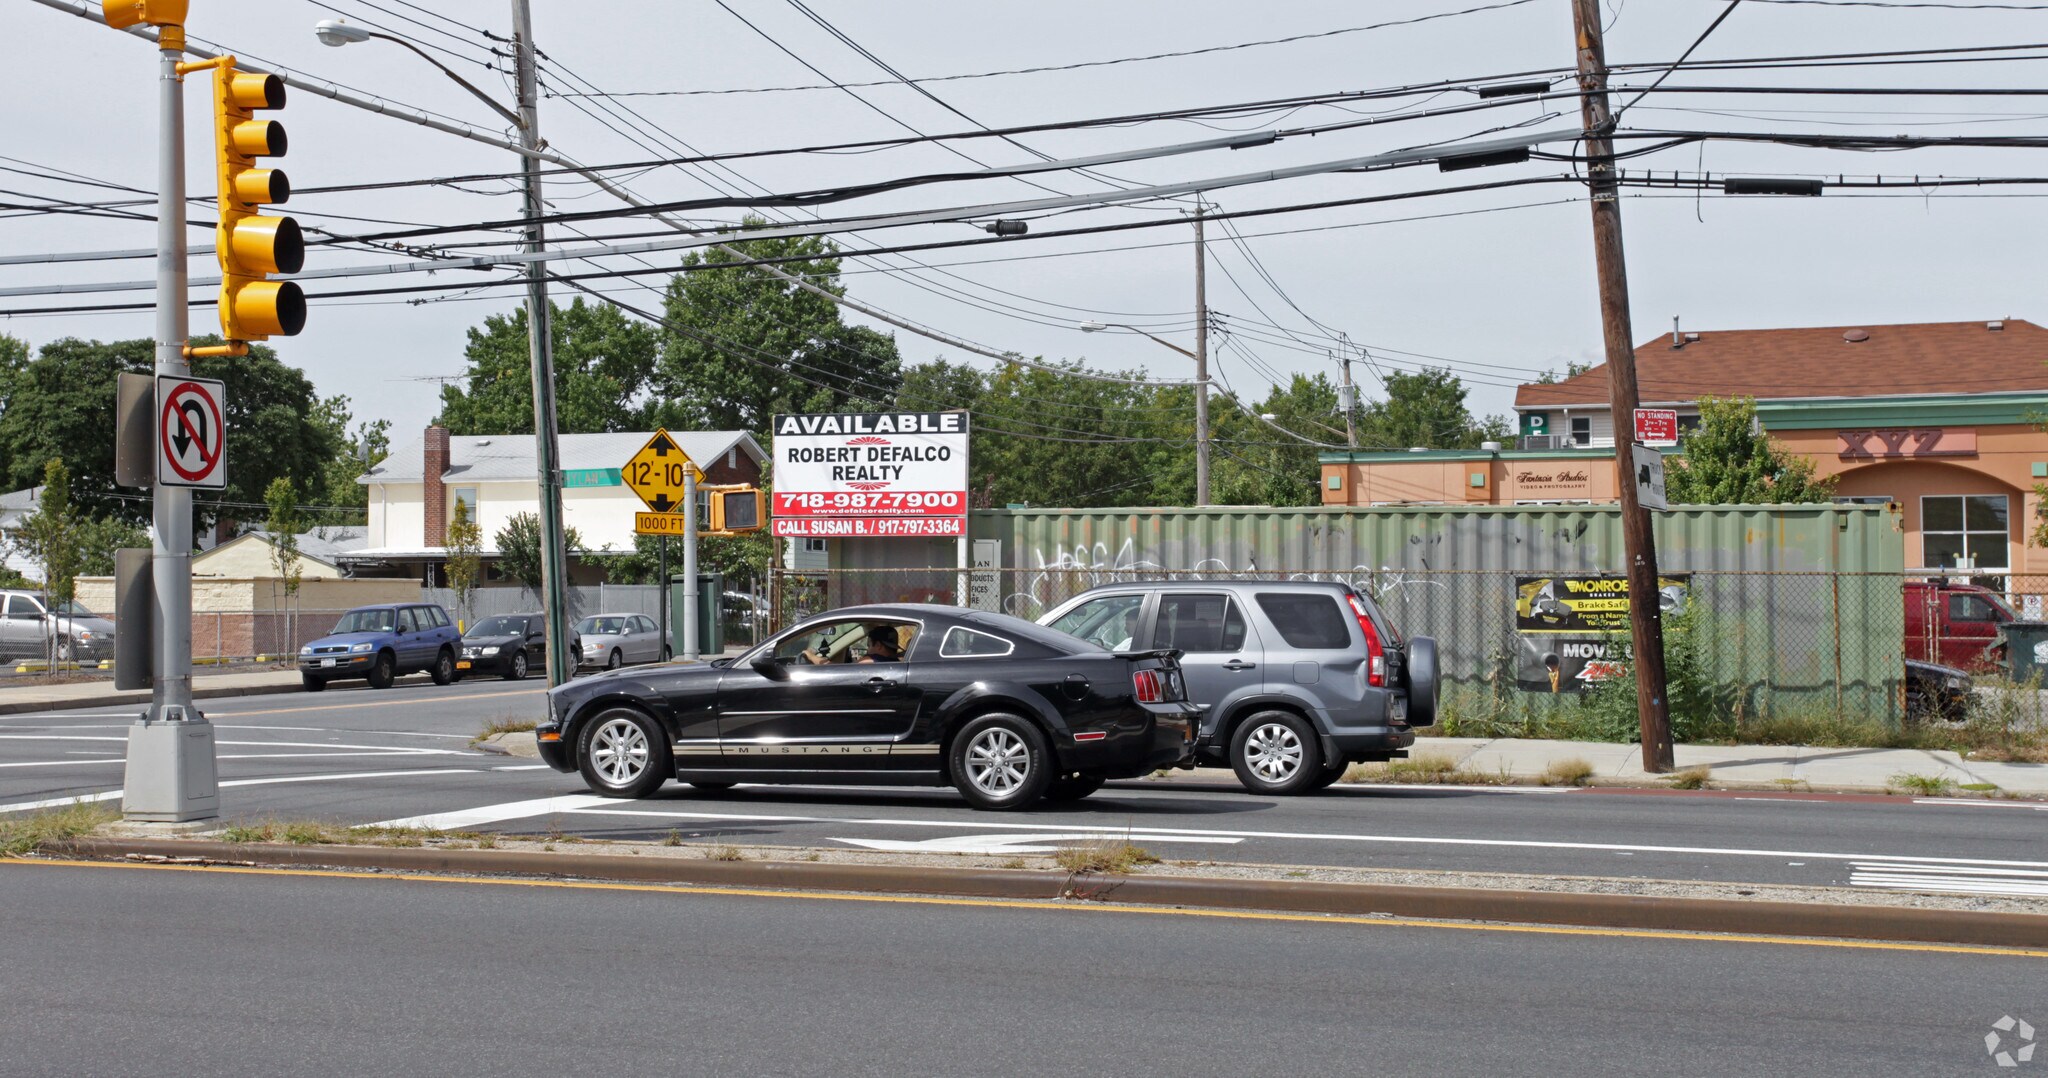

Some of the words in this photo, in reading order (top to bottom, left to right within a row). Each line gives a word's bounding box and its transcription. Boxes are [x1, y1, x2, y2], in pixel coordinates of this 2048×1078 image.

[1647, 412, 1674, 420] STANDING
[780, 414, 959, 434] AVAILABLE
[1838, 429, 1943, 459] XYZ
[788, 447, 861, 463] ROBERT
[867, 445, 951, 462] DEFALCO
[832, 464, 903, 481] REALTY
[1556, 470, 1588, 483] Studios
[780, 492, 958, 508] 718-987-7900
[811, 507, 925, 515] www.defalcorealty.com
[640, 517, 667, 530] 1000
[671, 518, 684, 530] FT
[777, 520, 809, 534] CALL
[811, 520, 854, 534] SUSAN
[855, 520, 868, 534] B.
[878, 519, 960, 534] 917-797-3364
[1575, 579, 1629, 592] MONROE
[1563, 643, 1618, 658] MOV
